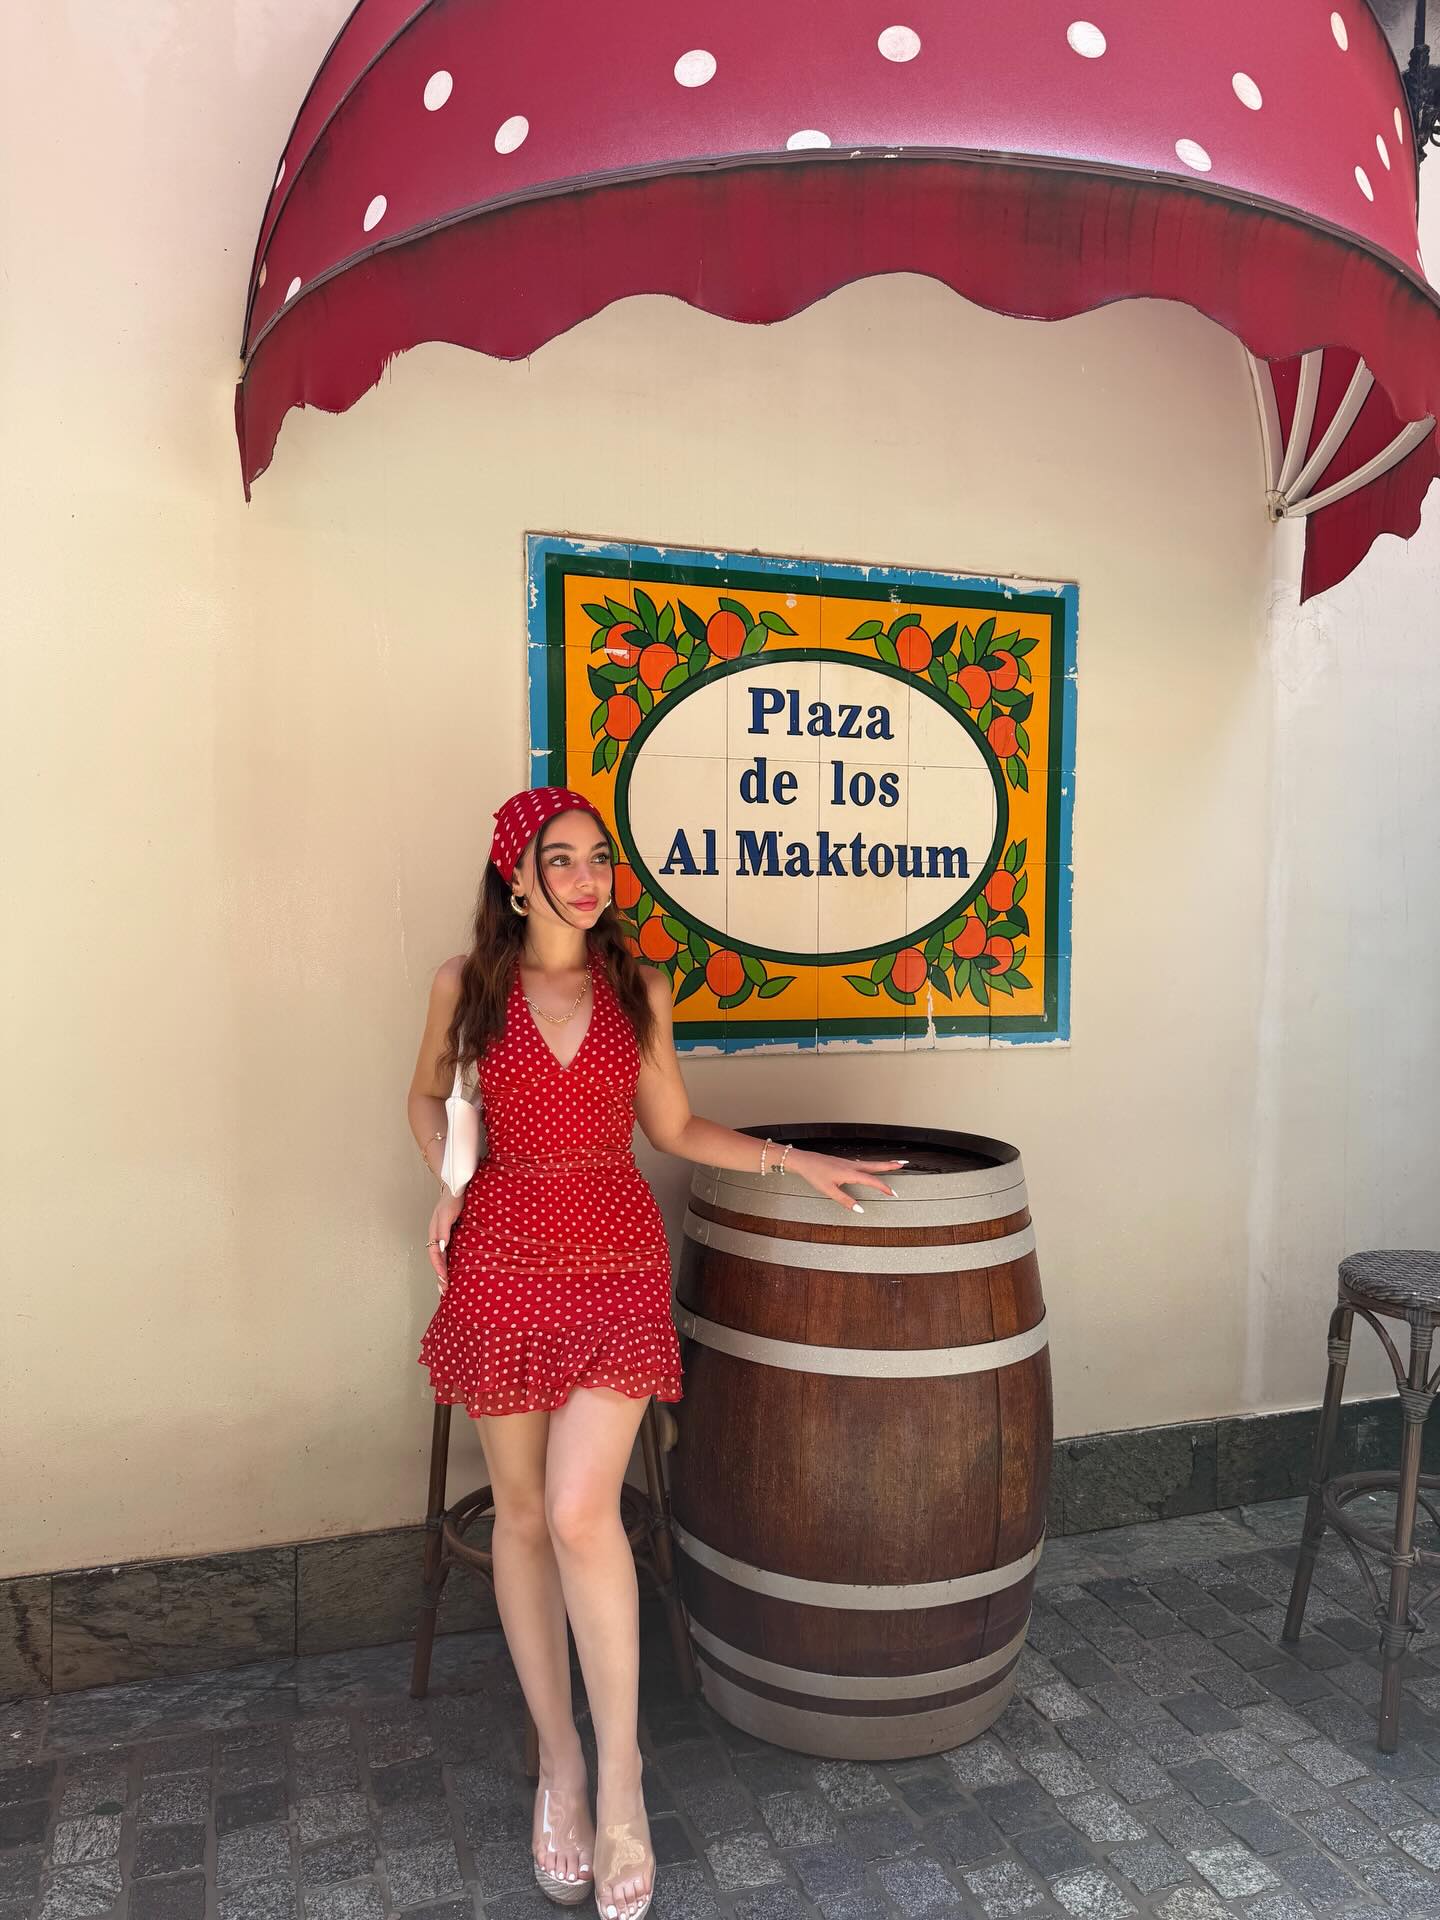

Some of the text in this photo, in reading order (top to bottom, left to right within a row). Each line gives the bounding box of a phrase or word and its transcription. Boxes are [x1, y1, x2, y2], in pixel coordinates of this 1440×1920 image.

[747, 687, 894, 741] Plaza
[739, 756, 900, 808] de los
[658, 828, 970, 879] Al Maktoum
